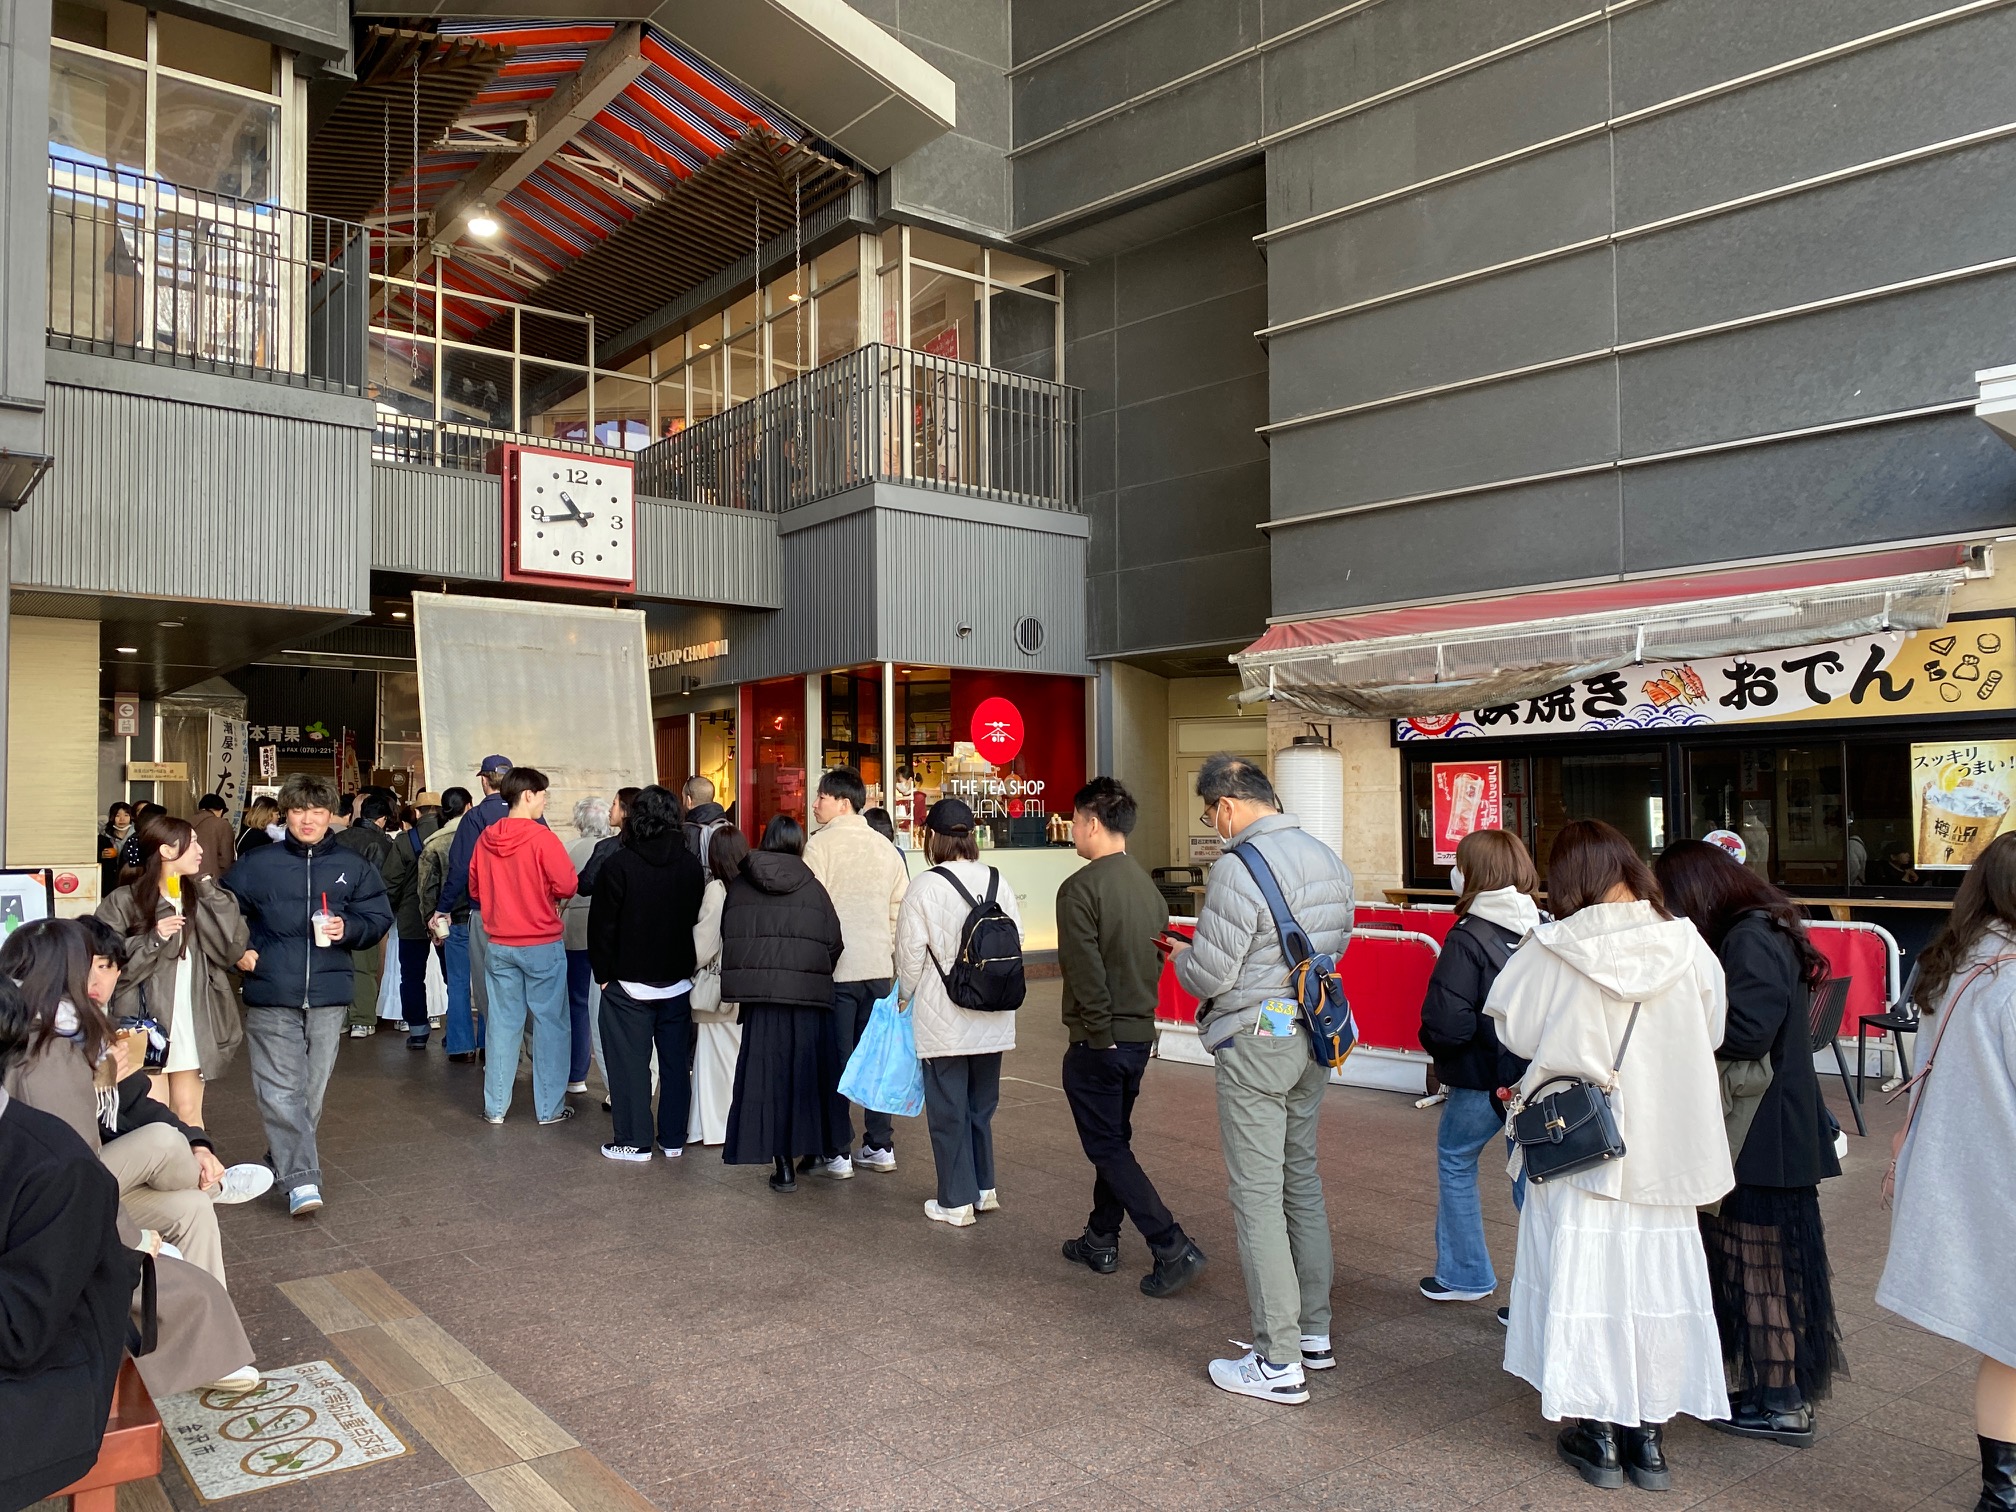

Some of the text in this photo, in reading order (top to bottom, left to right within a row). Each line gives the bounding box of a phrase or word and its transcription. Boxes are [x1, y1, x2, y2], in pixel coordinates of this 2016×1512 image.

[565, 468, 589, 485] 12
[610, 515, 624, 530] 3
[570, 550, 585, 565] 6
[1719, 643, 1915, 711] おでん
[1912, 747, 1978, 770] スッキリ
[951, 779, 1045, 796] THE TEA SHOP
